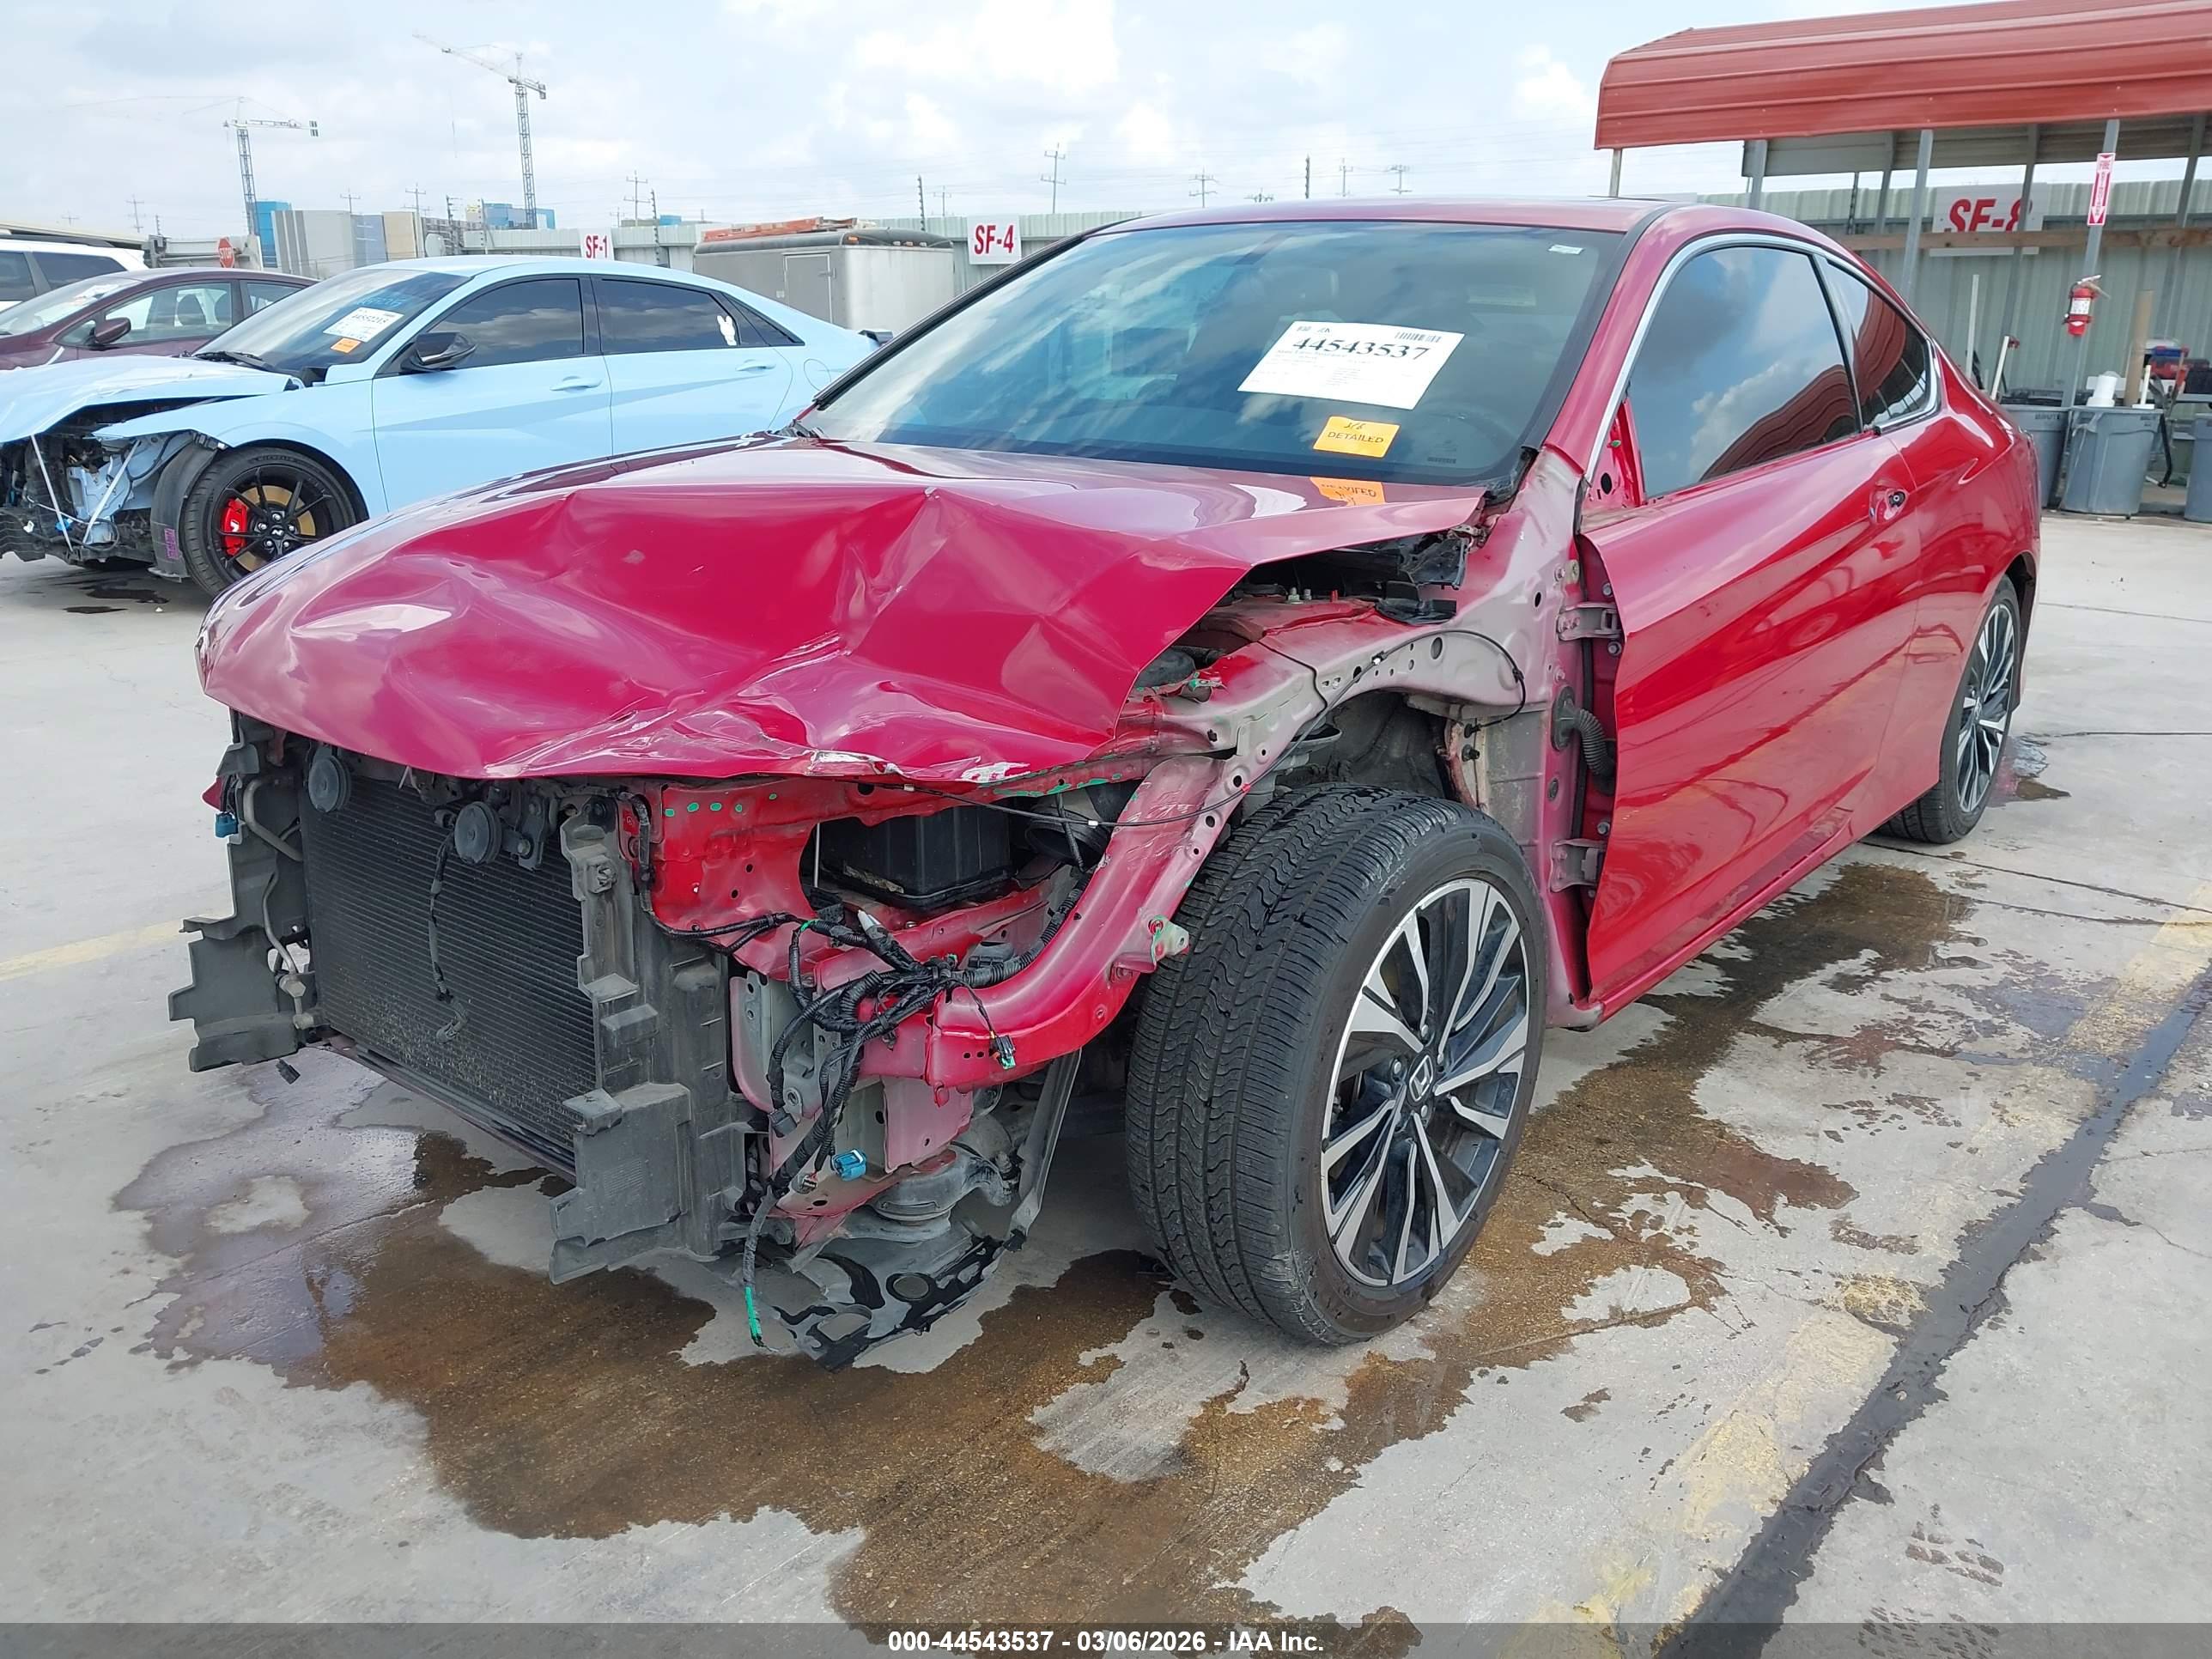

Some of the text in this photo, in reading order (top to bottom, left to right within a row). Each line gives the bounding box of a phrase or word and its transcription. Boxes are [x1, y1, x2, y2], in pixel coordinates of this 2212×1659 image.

[586, 234, 608, 259] SF-1
[974, 224, 1014, 255] SF-4
[1292, 337, 1432, 361] 44543537
[1328, 430, 1385, 444] DETAILED
